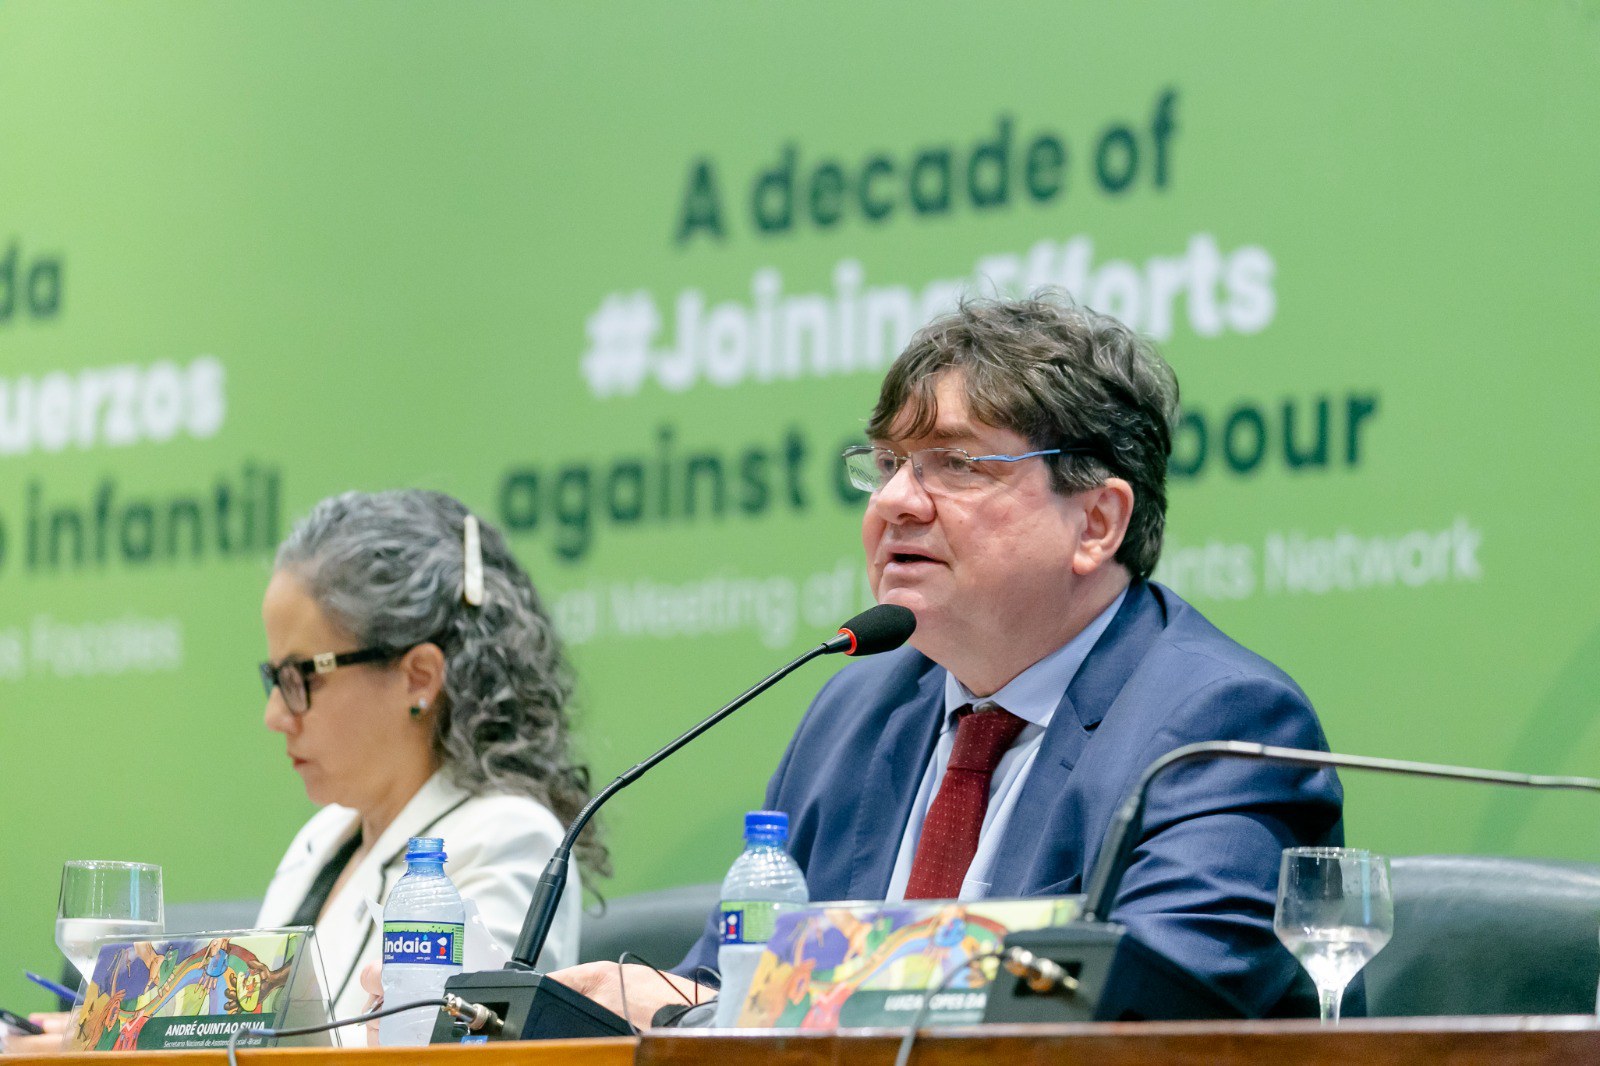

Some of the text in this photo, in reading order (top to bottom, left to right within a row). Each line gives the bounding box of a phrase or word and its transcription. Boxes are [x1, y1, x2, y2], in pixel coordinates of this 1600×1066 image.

[674, 84, 1180, 248] A decade of
[25, 458, 281, 578] infantil
[499, 422, 808, 562] against
[1263, 517, 1482, 596] Network
[165, 1020, 198, 1036] ANDRÉ
[197, 1022, 239, 1036] QUINTAO
